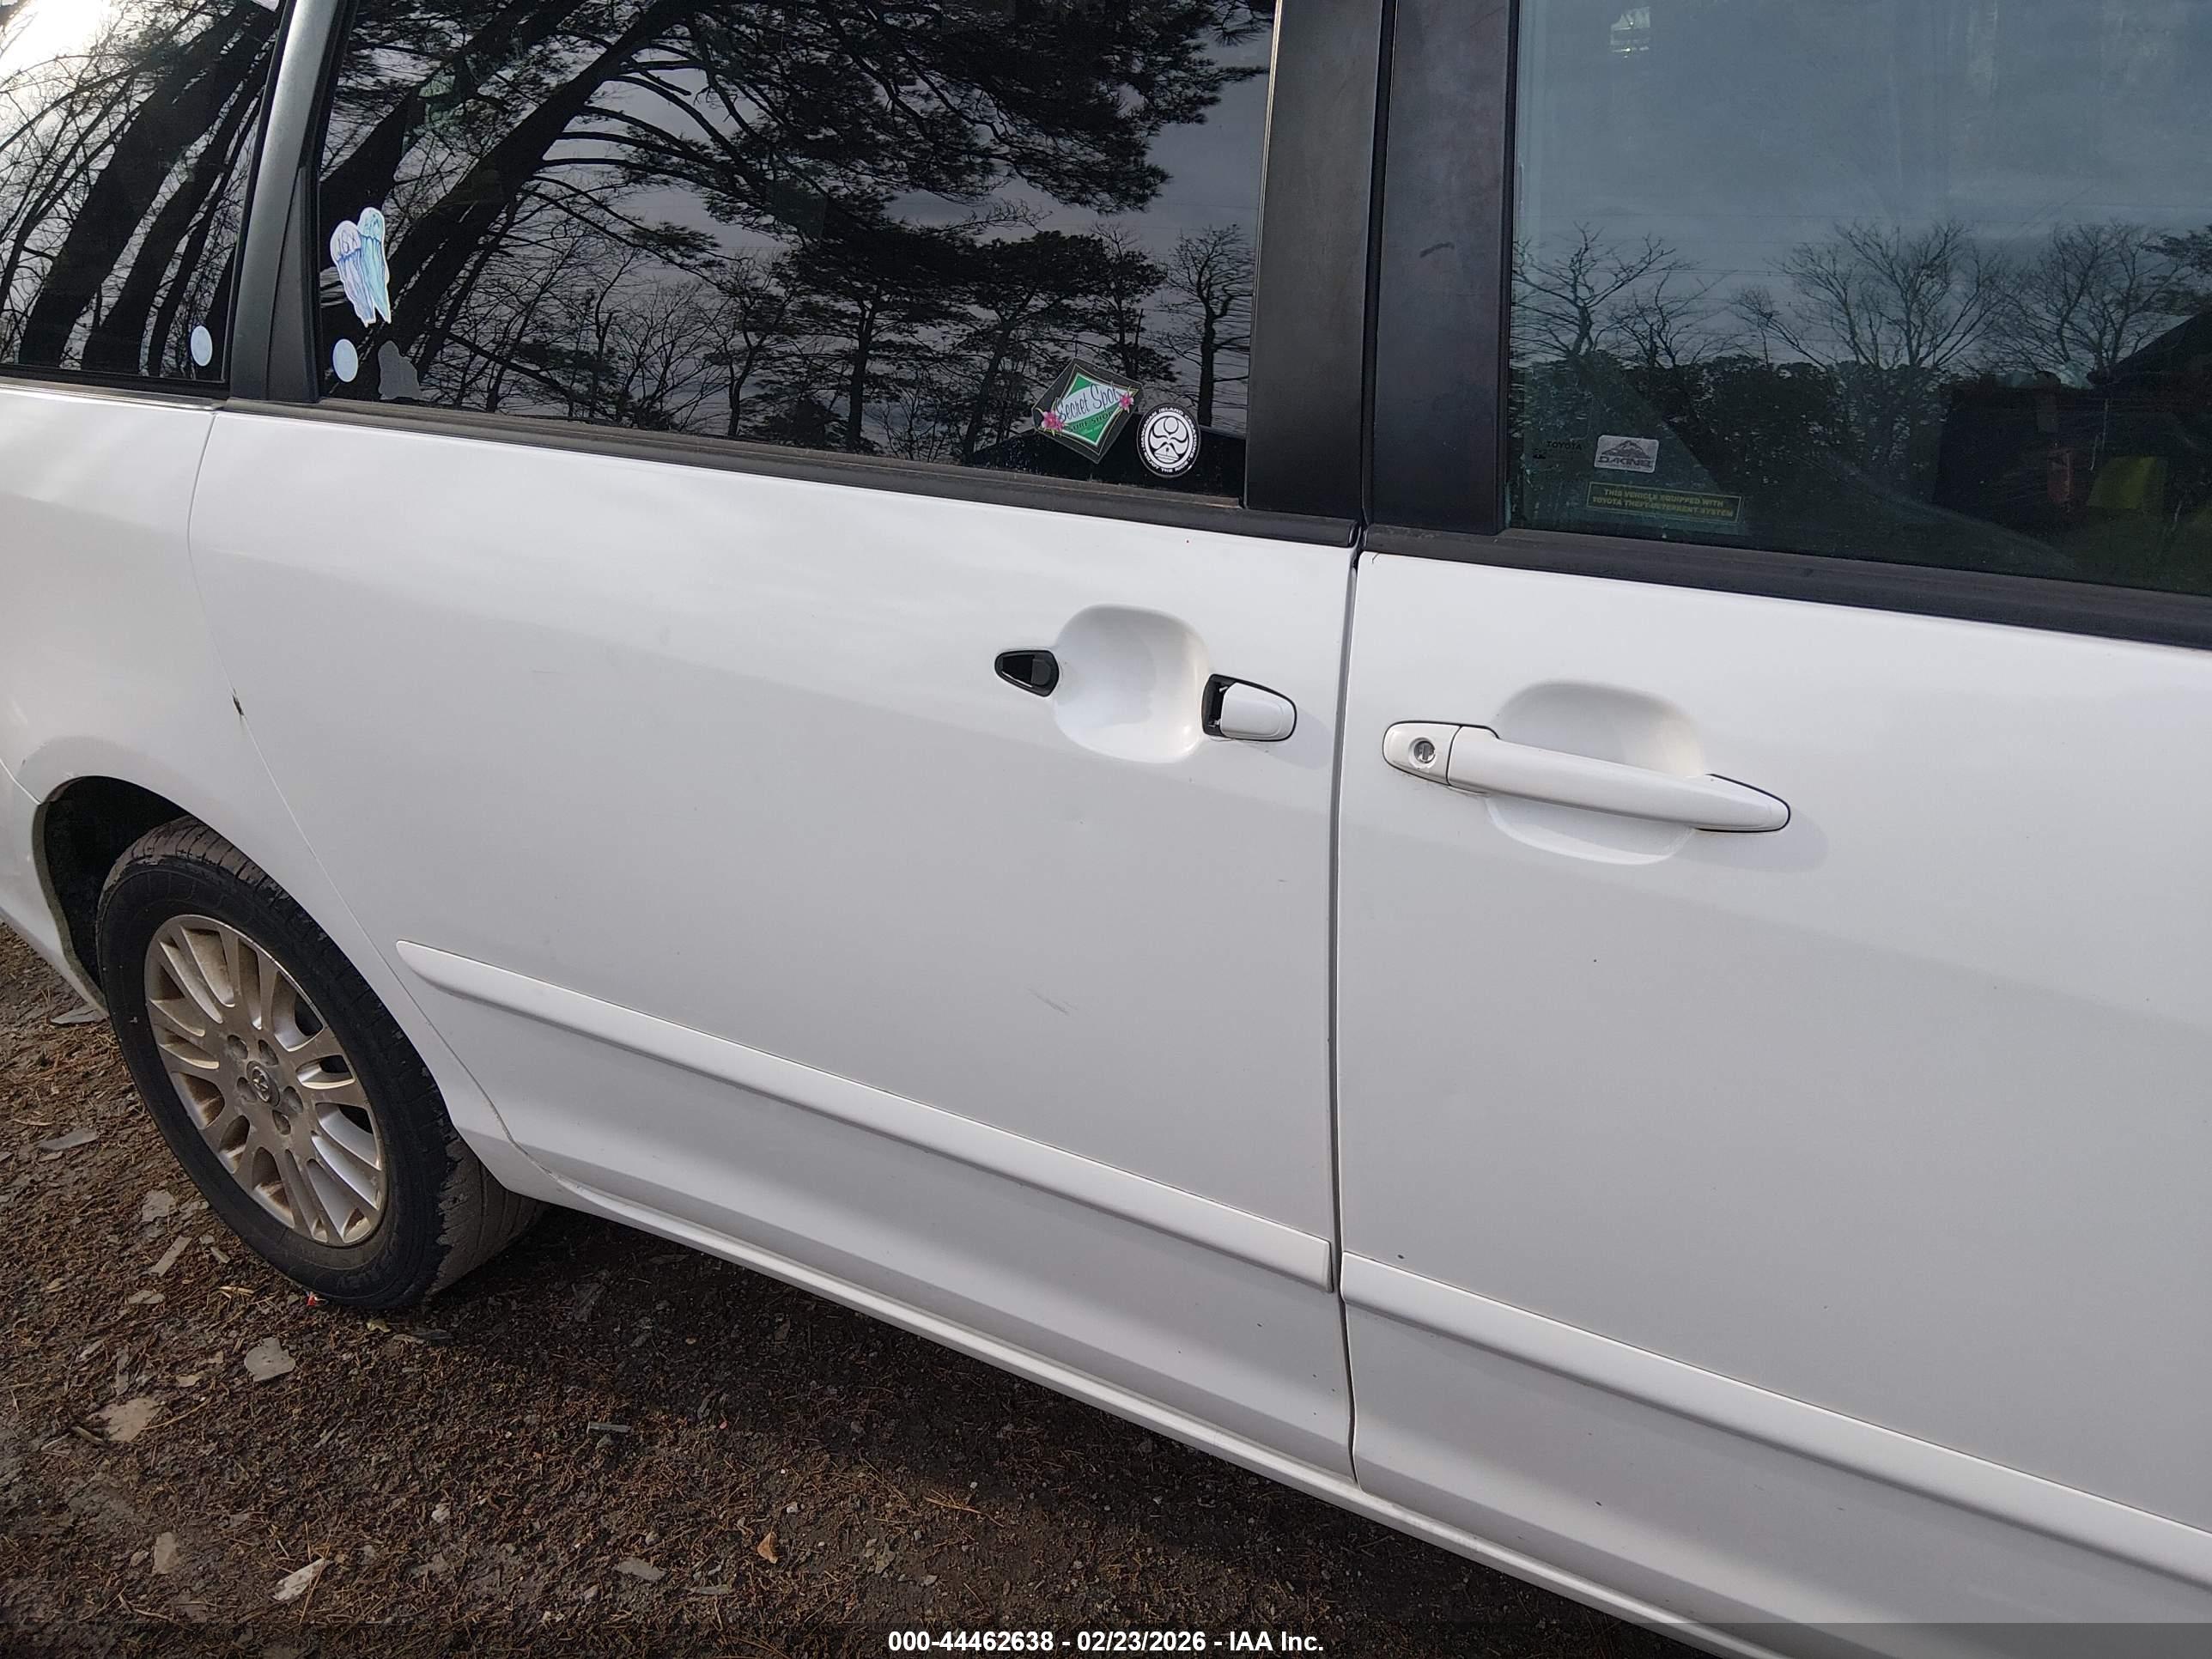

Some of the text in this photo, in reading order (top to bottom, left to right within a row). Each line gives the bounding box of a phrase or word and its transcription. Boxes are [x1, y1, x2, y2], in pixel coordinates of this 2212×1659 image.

[1055, 380, 1119, 422] Secret Spot
[1091, 410, 1113, 423] SHOP
[1158, 407, 1184, 416] ISLAND
[1184, 415, 1197, 459] CREATIONS
[1546, 441, 1582, 451] TOYOTA
[1604, 488, 1622, 496] THIS
[1593, 496, 1622, 505] TOYOTA
